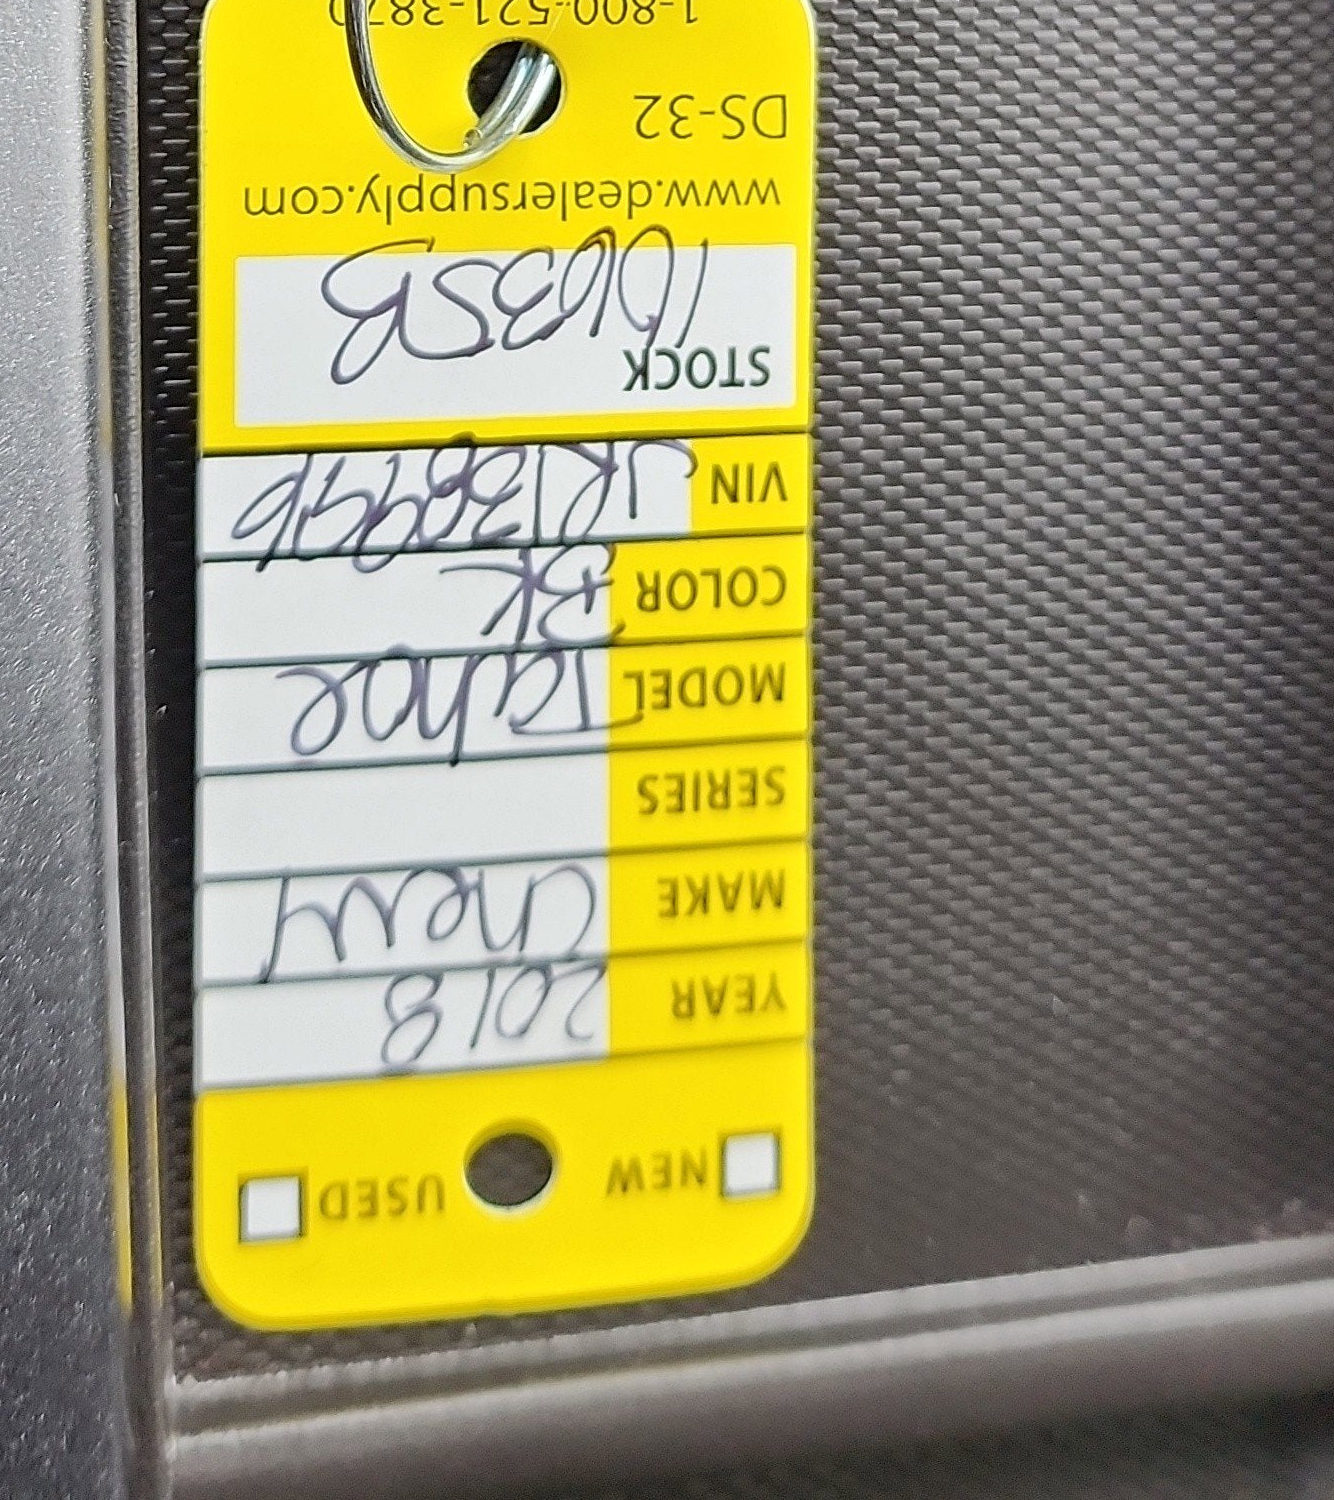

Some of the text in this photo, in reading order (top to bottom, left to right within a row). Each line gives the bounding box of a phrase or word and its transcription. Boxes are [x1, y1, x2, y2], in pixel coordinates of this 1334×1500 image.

[634, 93, 788, 140] DS-32
[244, 173, 781, 224] www.dealersupply.com
[623, 346, 771, 391] STOCK
[712, 461, 788, 503] VIN
[637, 566, 787, 613] COLOR
[276, 644, 643, 767] Tahoe
[624, 661, 786, 710] MODEL
[639, 765, 787, 816] SERIES
[658, 868, 786, 918] MAKE
[381, 959, 607, 1077] 2018
[672, 971, 788, 1020] YEAR
[320, 1173, 445, 1219] USED
[607, 1148, 707, 1196] NEW
